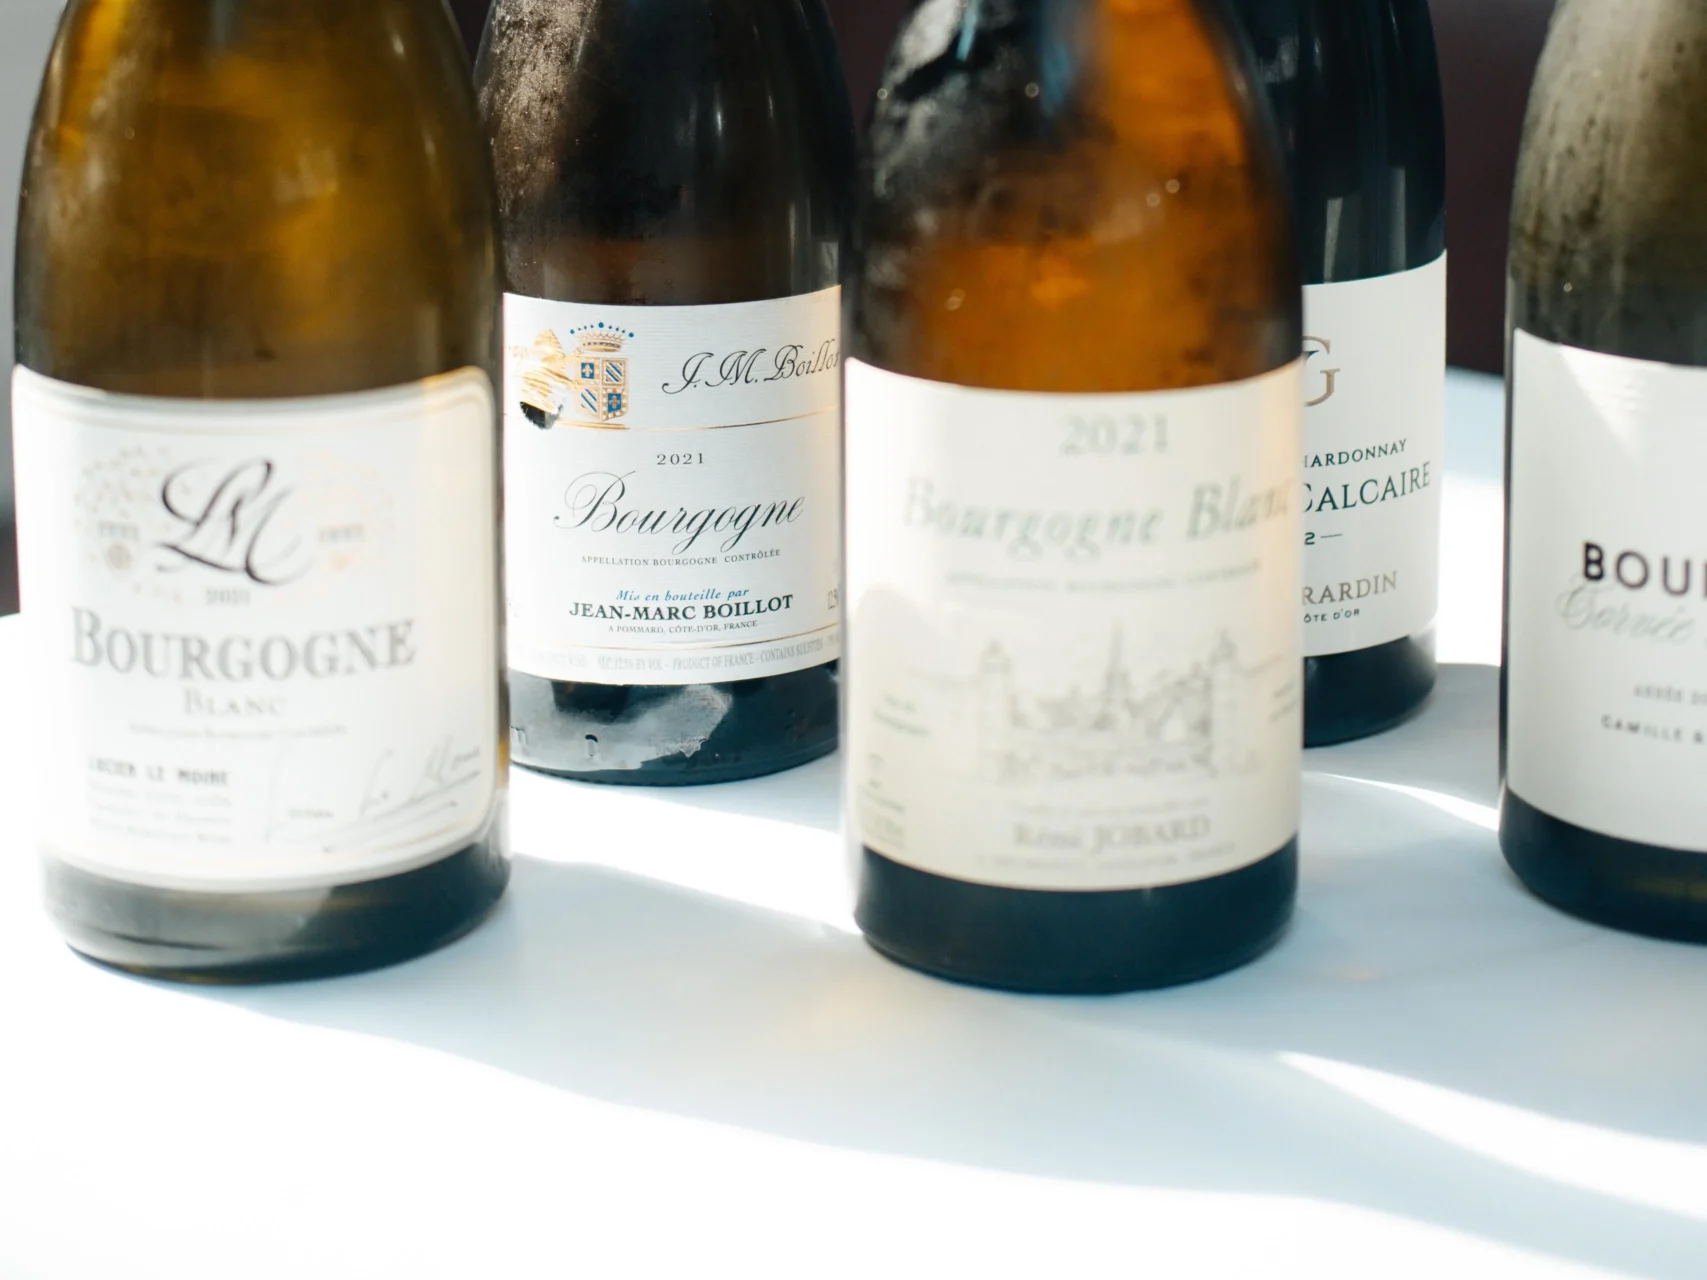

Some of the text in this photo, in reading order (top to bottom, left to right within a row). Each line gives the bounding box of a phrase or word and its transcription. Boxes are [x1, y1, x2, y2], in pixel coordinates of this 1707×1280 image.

[1060, 412, 1169, 456] 2021
[656, 452, 705, 466] 2021
[553, 470, 806, 556] Bourgogne
[902, 475, 1165, 562] Bourgogne
[581, 548, 781, 567] APPELLATION BOURGOGNE CONTRÔLÉE
[1581, 539, 1707, 602] BOU
[569, 593, 794, 621] JEAN-MARC BOILLOT
[615, 587, 750, 602] Mis en bouteille par
[724, 619, 758, 631] FRANCE
[72, 605, 417, 683] BOURGOGNE
[672, 656, 710, 670] PRODUCT
[712, 656, 721, 669] OF
[724, 652, 755, 667] FRANCE
[760, 646, 795, 663] CONTAINS
[1599, 713, 1683, 742] CAMILLE
